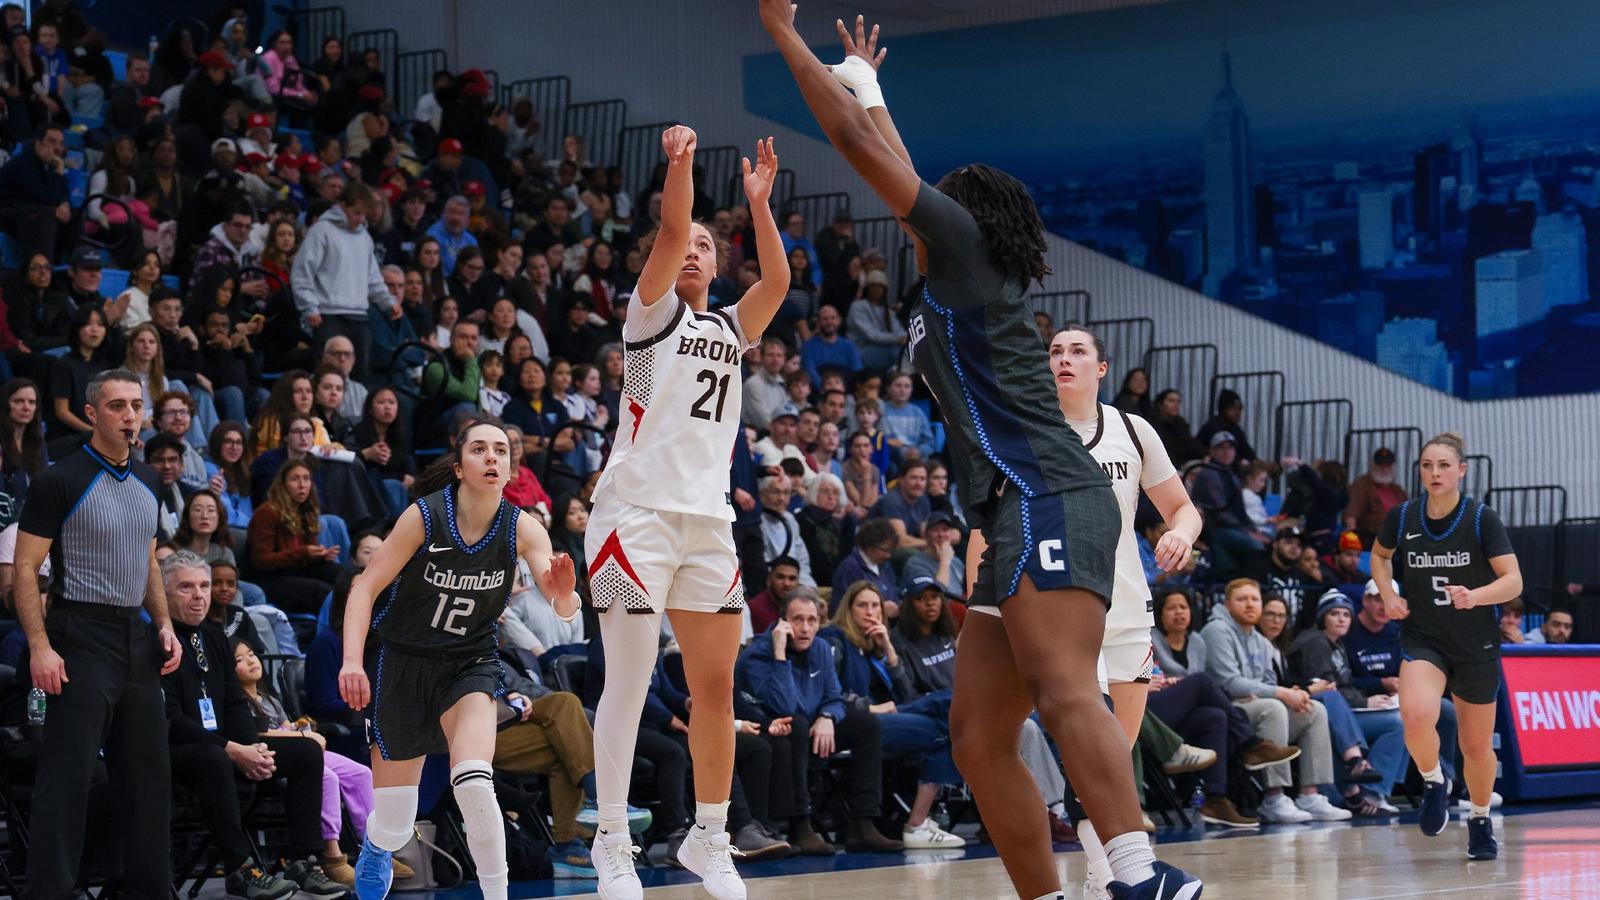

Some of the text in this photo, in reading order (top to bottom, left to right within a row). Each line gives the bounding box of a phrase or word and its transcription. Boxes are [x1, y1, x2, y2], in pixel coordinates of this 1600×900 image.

[690, 369, 731, 422] 21
[1039, 539, 1065, 571] C
[1408, 551, 1471, 568] Columbia
[424, 561, 505, 590] Columbia
[1432, 576, 1451, 606] 5
[431, 593, 476, 636] 12
[1515, 691, 1567, 731] FAN
